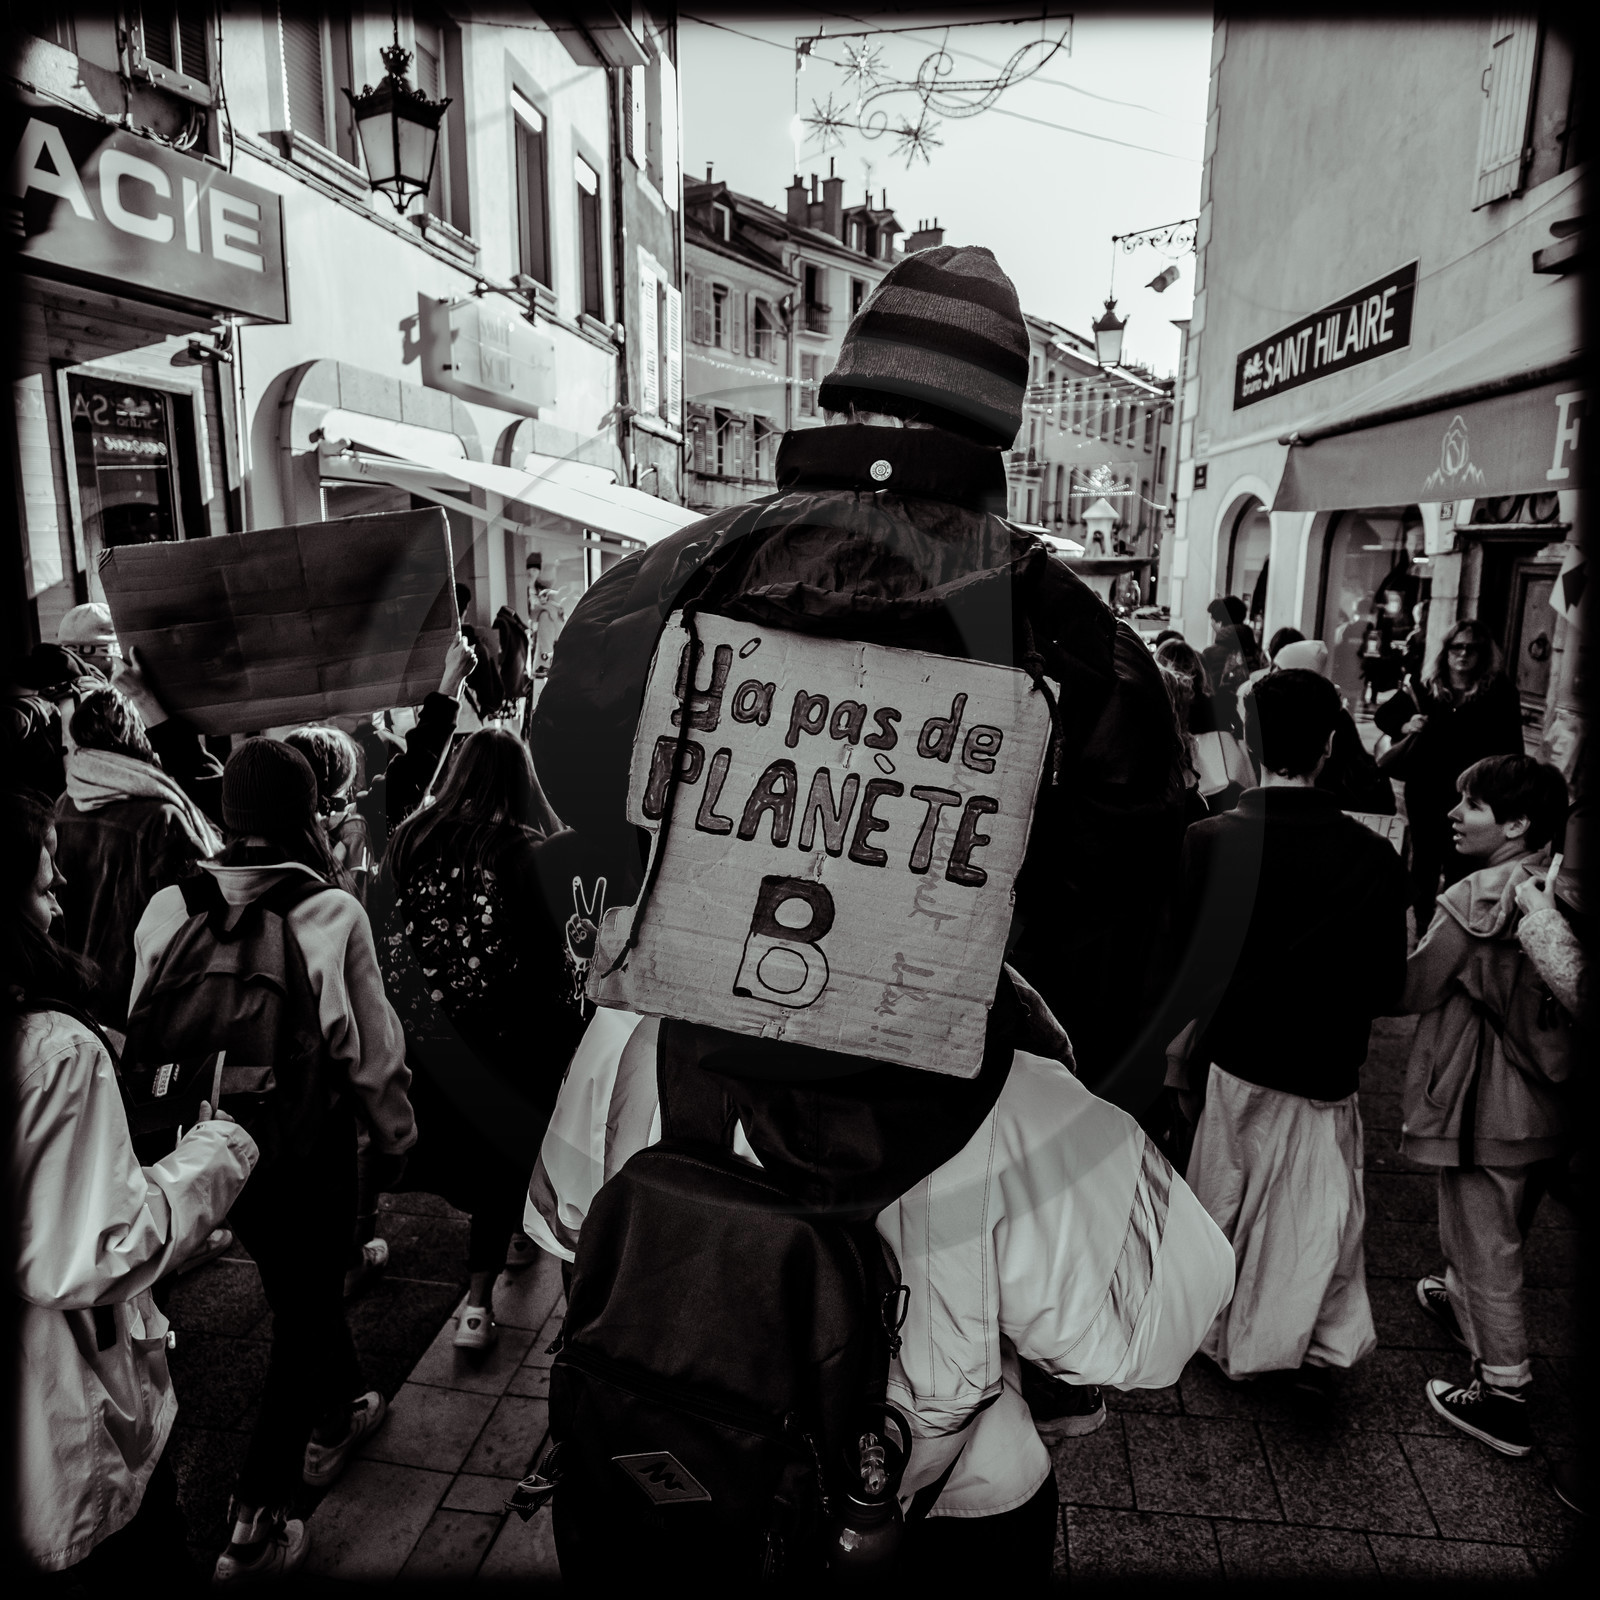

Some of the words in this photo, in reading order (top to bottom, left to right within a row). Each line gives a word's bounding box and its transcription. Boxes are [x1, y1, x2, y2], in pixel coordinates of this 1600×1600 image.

[18, 117, 266, 273] ACIE
[1262, 325, 1313, 390] SAINT
[1312, 286, 1398, 368] HILAIRE
[785, 690, 901, 748] pas
[917, 693, 1004, 774] de
[642, 735, 999, 887] PLANÈTE
[733, 875, 835, 1009] B
